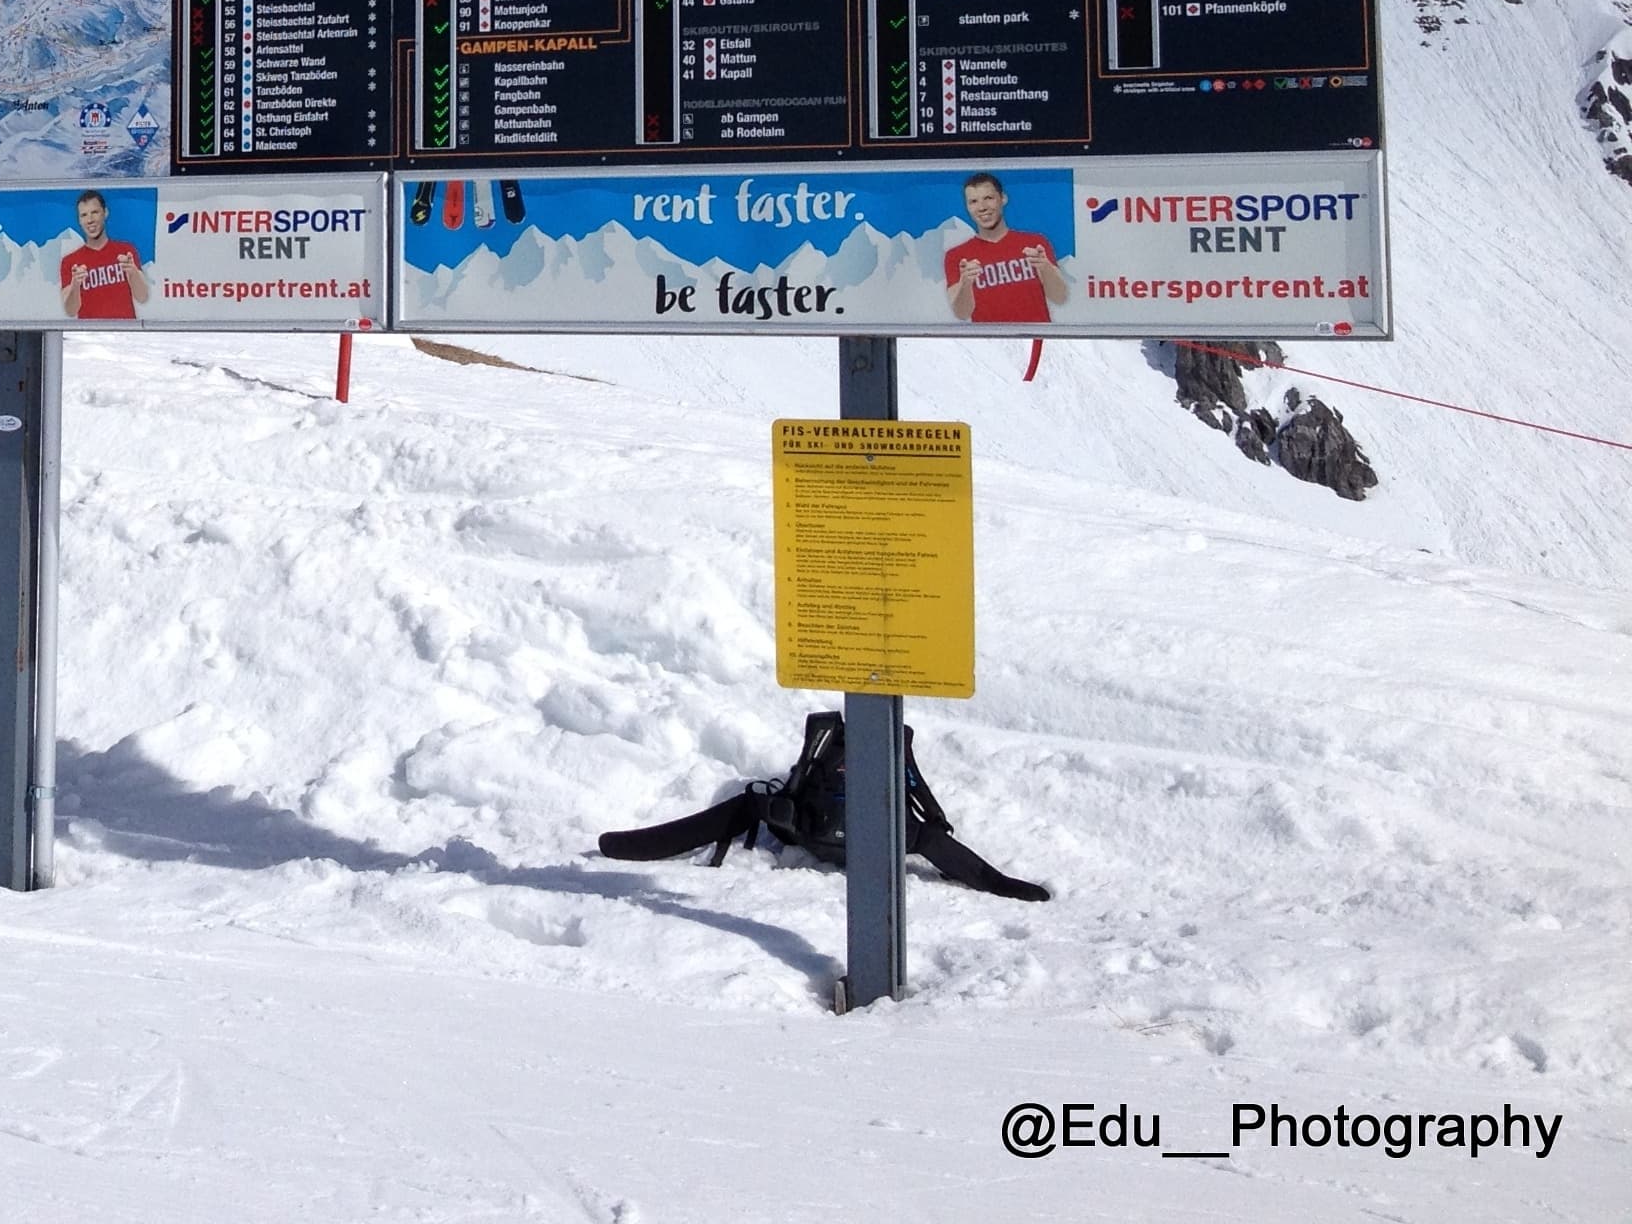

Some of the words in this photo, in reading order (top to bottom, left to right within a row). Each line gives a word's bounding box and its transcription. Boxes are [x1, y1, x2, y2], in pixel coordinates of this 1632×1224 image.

[959, 15, 1000, 25] stanton
[1003, 12, 1029, 24] park
[1162, 5, 1182, 16] 101
[1205, 1, 1287, 17] Pfannenköpfe
[460, 37, 597, 55] GAMPEN-KAPALL
[960, 90, 1049, 103] Restauranthang
[633, 184, 717, 224] rent
[735, 178, 865, 227] faster.
[1125, 193, 1360, 223] INTERSPORT
[192, 209, 366, 233] INTERSPORT
[239, 237, 310, 259] RENT
[1190, 226, 1286, 253] RENT
[81, 263, 126, 291] COACH
[975, 257, 1036, 289] COACH
[164, 278, 371, 302] intersportrent.at
[655, 274, 696, 314] be
[715, 272, 844, 320] faster.
[1088, 275, 1369, 303] intersportrent.at
[783, 426, 961, 440] FIS-VERHALTENSREGELN
